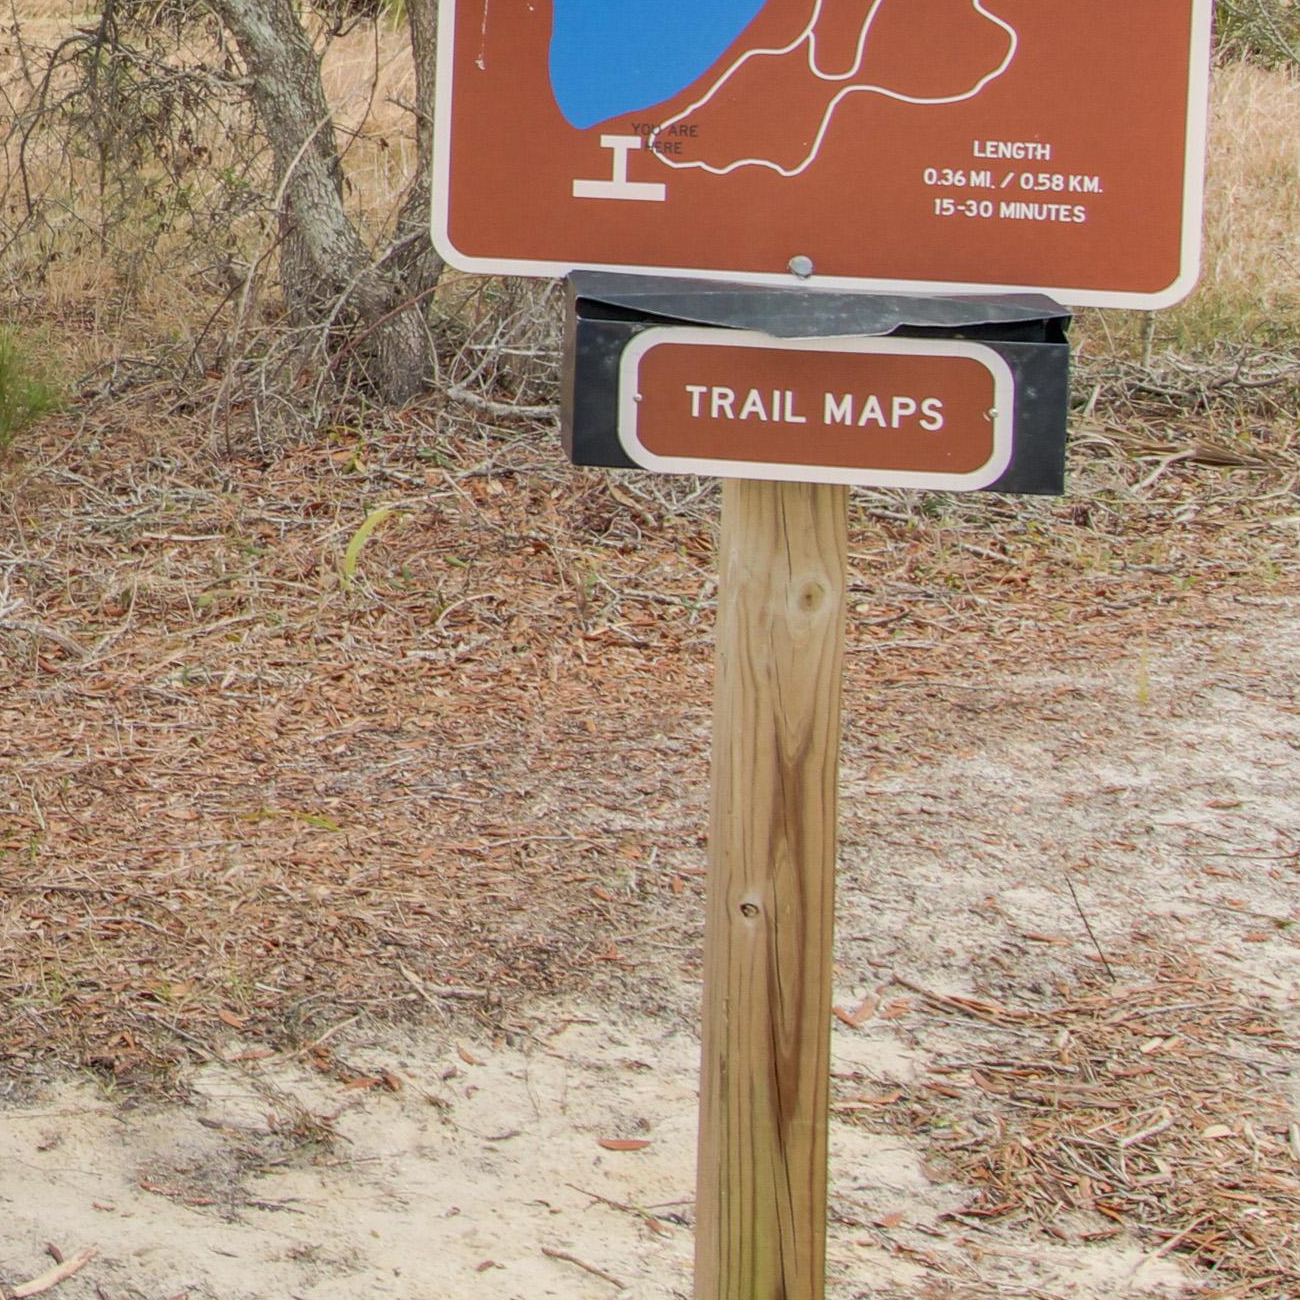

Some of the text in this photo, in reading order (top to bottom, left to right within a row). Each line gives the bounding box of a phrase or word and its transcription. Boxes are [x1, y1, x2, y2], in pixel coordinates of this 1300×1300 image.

[668, 124, 699, 138] ARE
[973, 140, 1051, 161] LENGTH
[923, 167, 1103, 193] 0.36 MI. / 0.58 KM.
[934, 198, 1087, 223] 15-30 MINUTES
[685, 384, 945, 432] TRAIL MAPS
